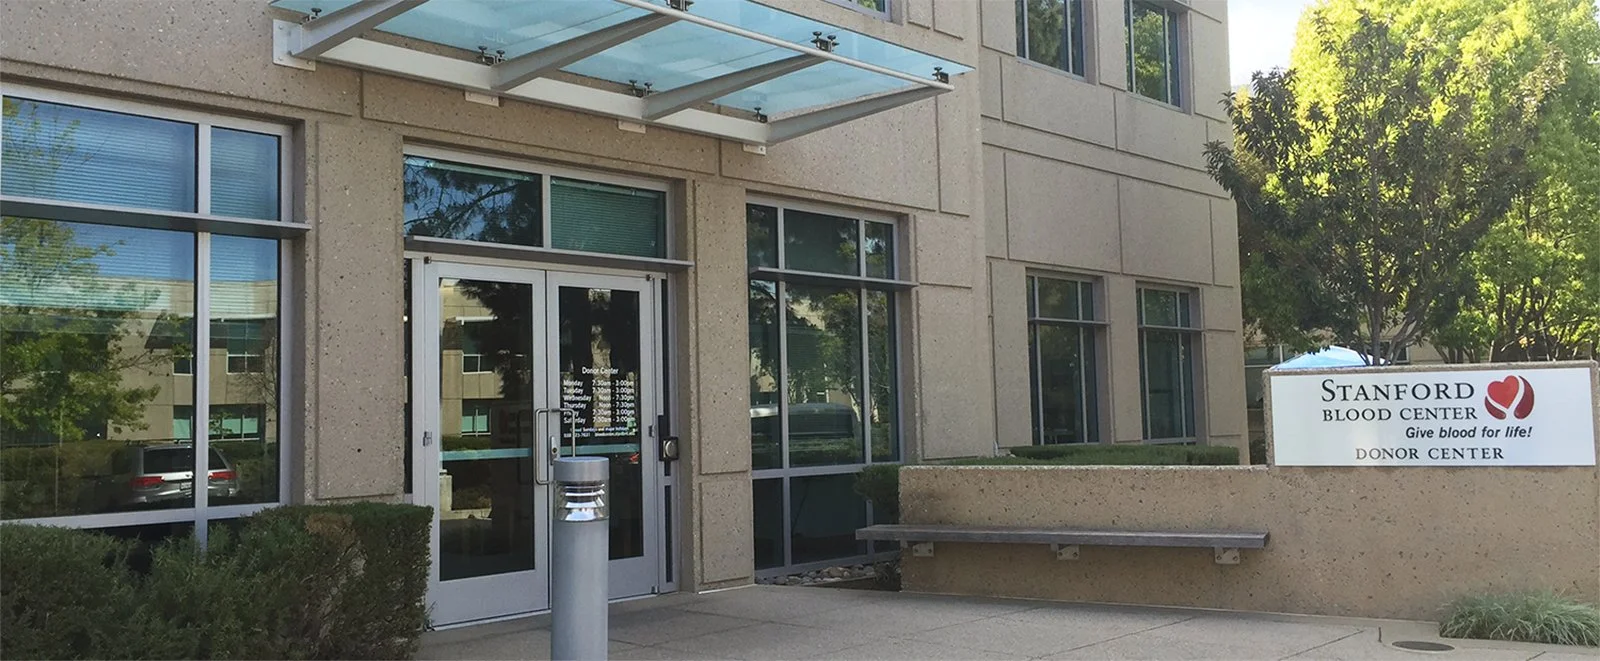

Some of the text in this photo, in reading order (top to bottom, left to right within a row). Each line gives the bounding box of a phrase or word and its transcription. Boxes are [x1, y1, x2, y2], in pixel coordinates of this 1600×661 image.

[1321, 378, 1475, 402] STANFORD
[1322, 406, 1479, 422] BLOOD CENTER
[1406, 426, 1533, 439] Give blood for life!
[1355, 447, 1504, 460] DONOR CENTER
